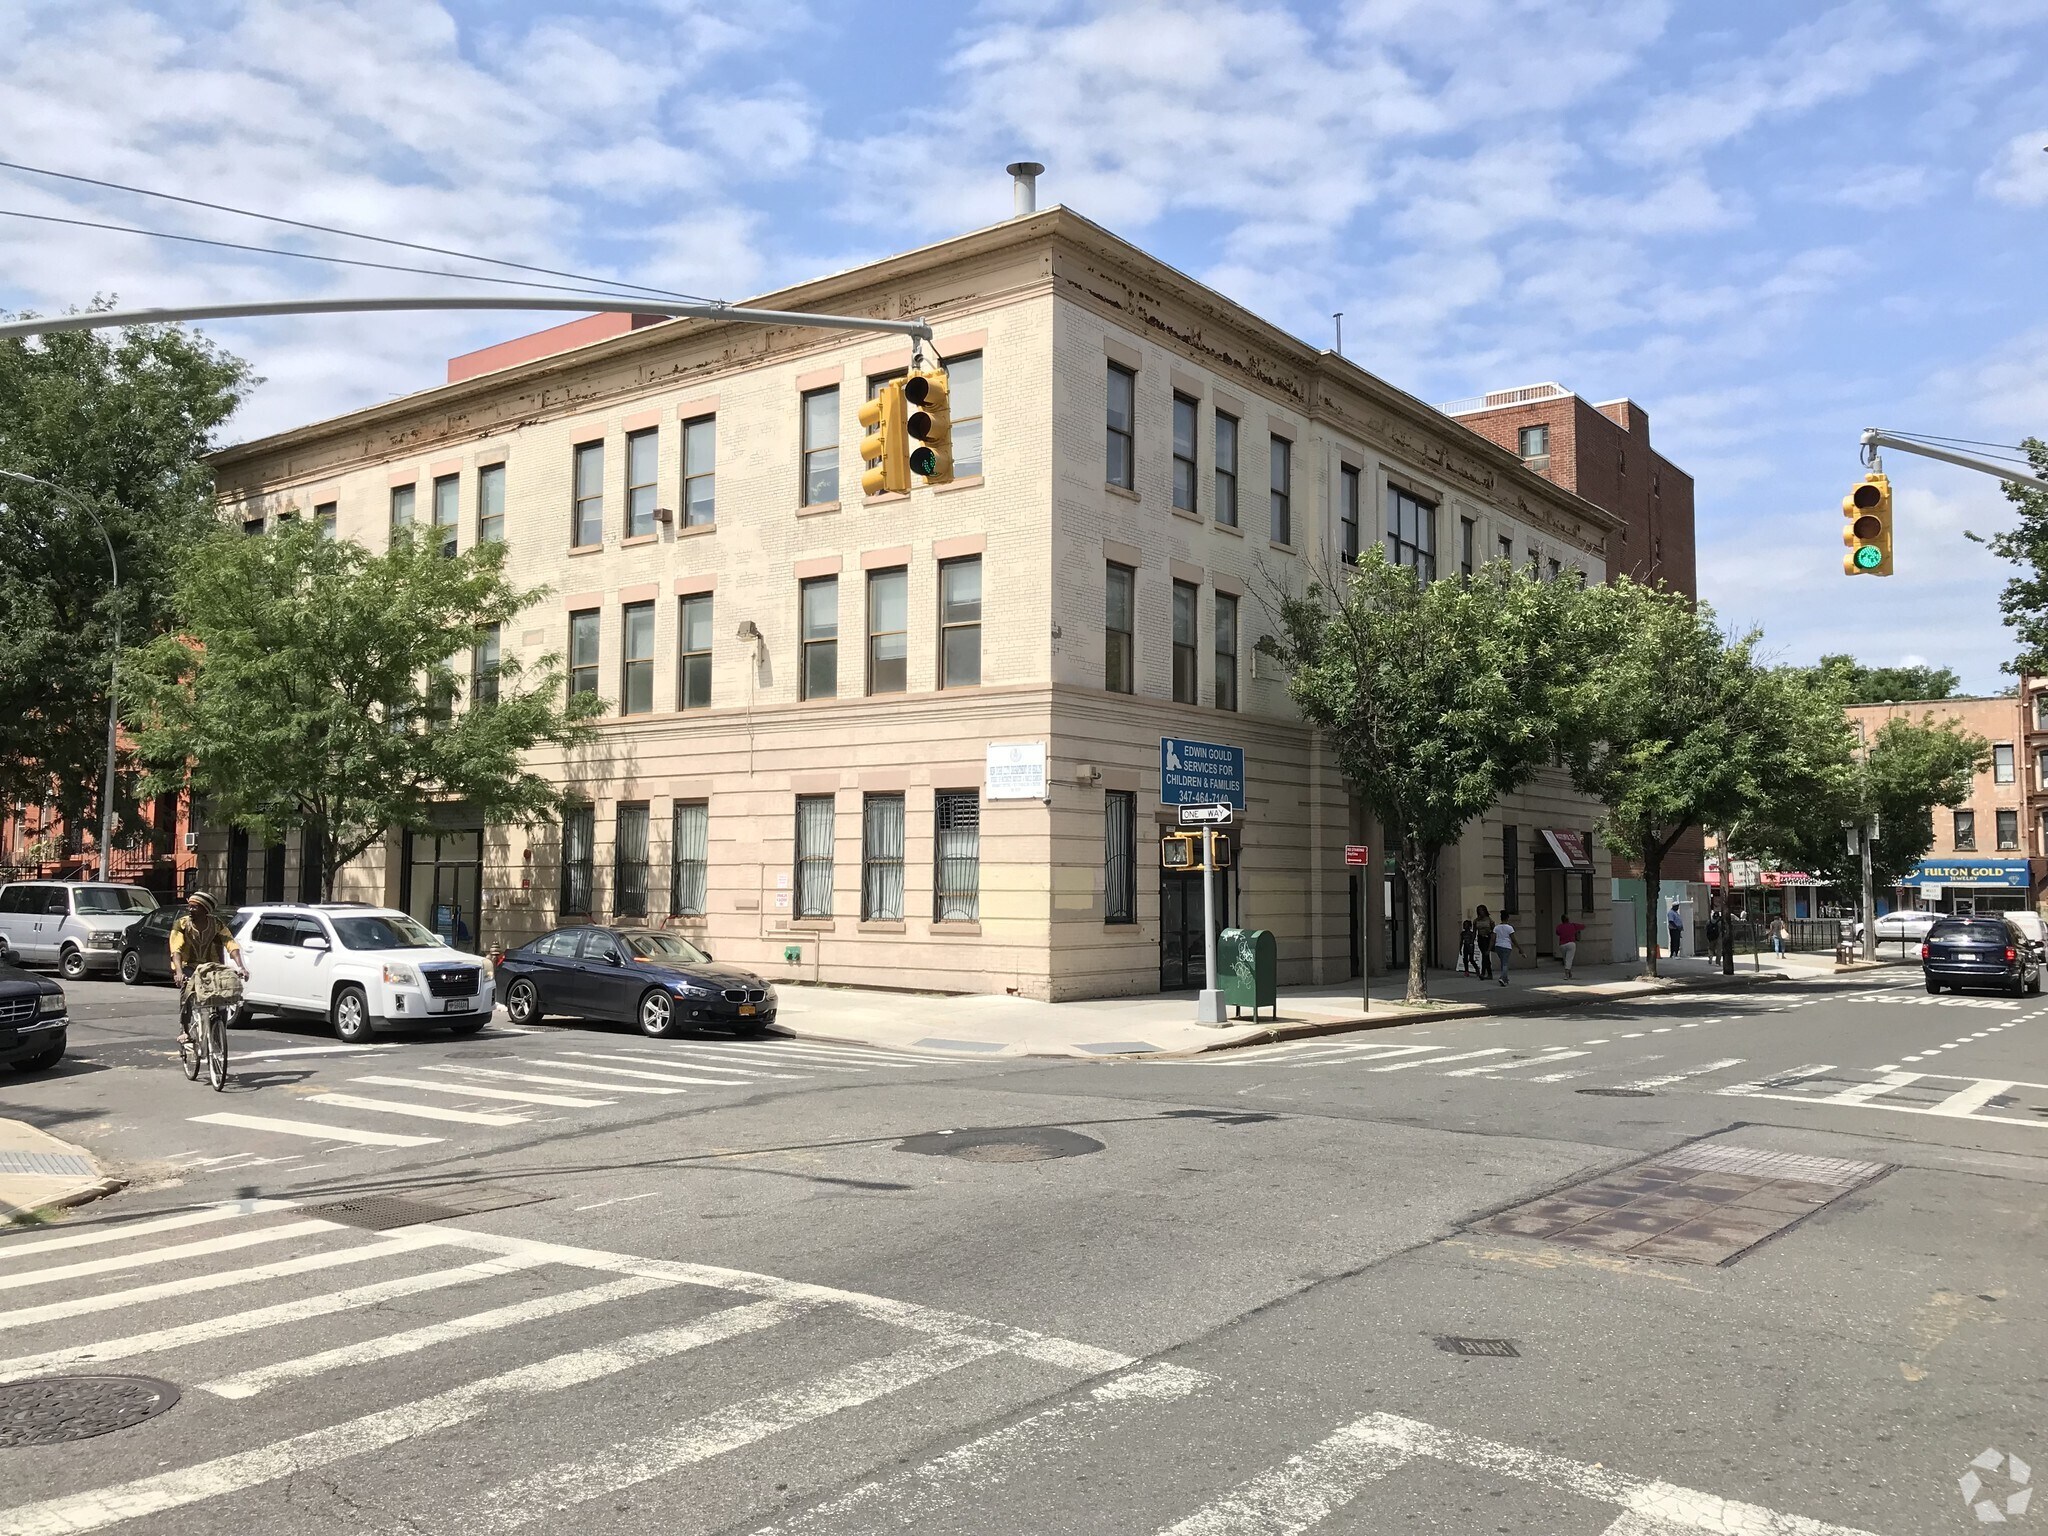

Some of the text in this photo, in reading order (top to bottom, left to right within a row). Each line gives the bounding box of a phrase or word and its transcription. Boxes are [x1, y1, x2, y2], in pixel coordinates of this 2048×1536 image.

[1184, 745, 1232, 761] EDWIN GOULD
[1183, 760, 1233, 776] SERVICES FOR
[1166, 773, 1240, 791] CHILDREN & FAMILIES
[1179, 790, 1229, 803] 347-464-7140
[1183, 809, 1224, 819] ONE WAY
[1924, 867, 2004, 877] FULTON GOLD
